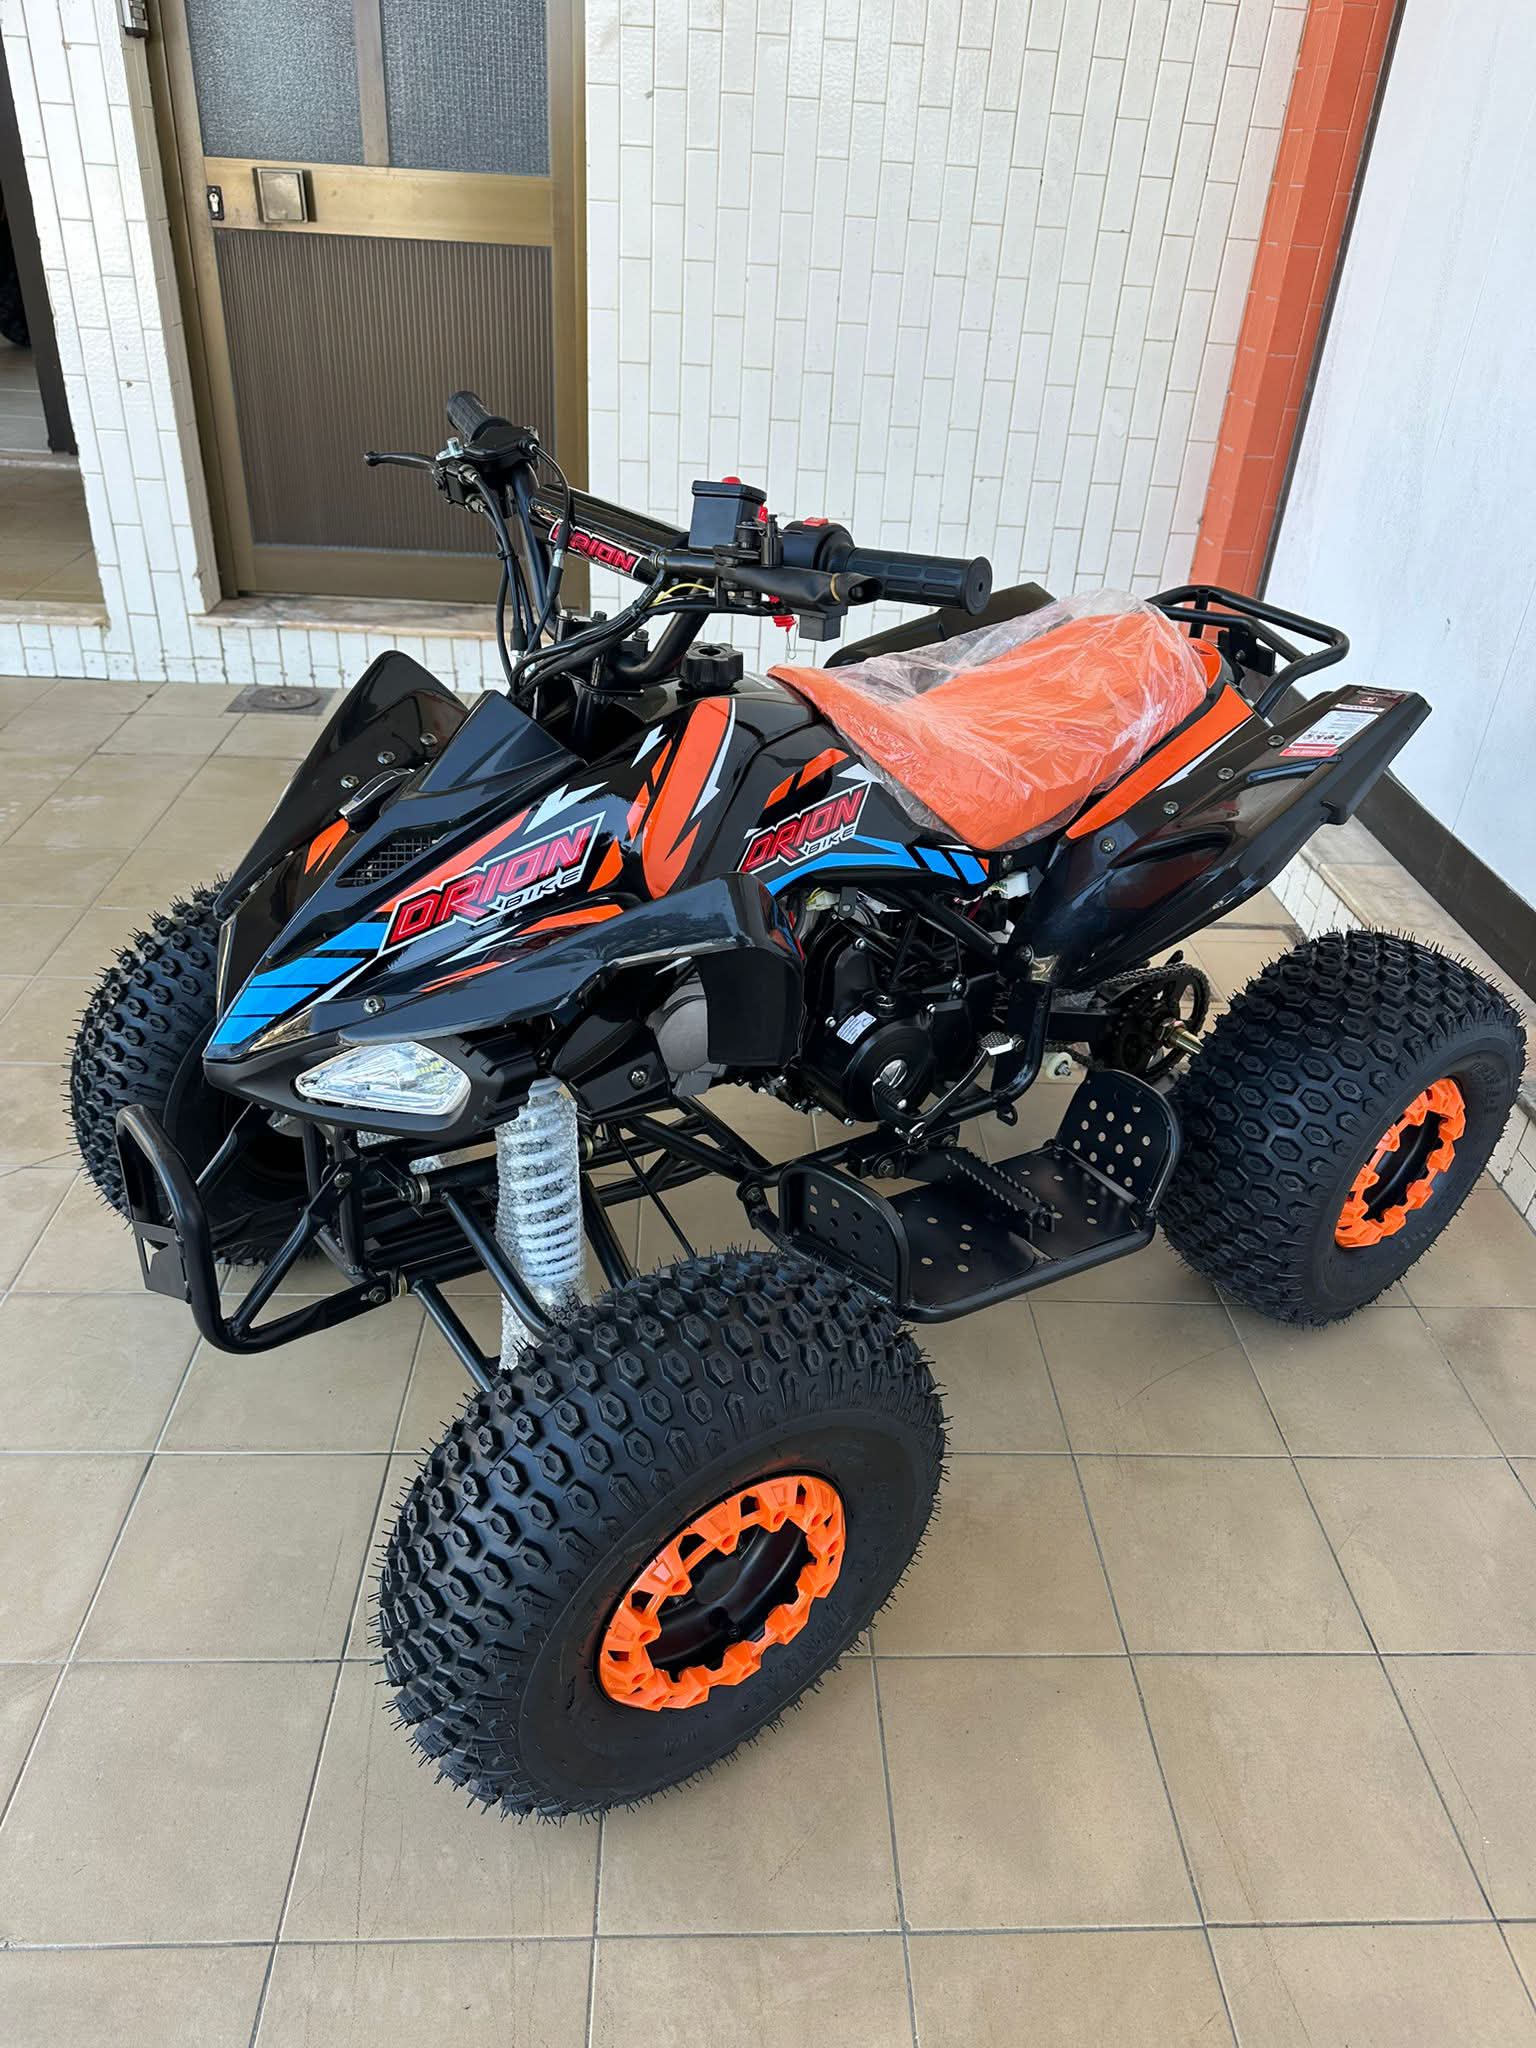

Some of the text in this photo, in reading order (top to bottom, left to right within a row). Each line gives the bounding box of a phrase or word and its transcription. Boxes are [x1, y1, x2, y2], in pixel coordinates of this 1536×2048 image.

[740, 790, 864, 873] ORION
[808, 826, 855, 854] BIKE
[390, 824, 593, 945] ORION
[503, 869, 580, 911] BIKE
